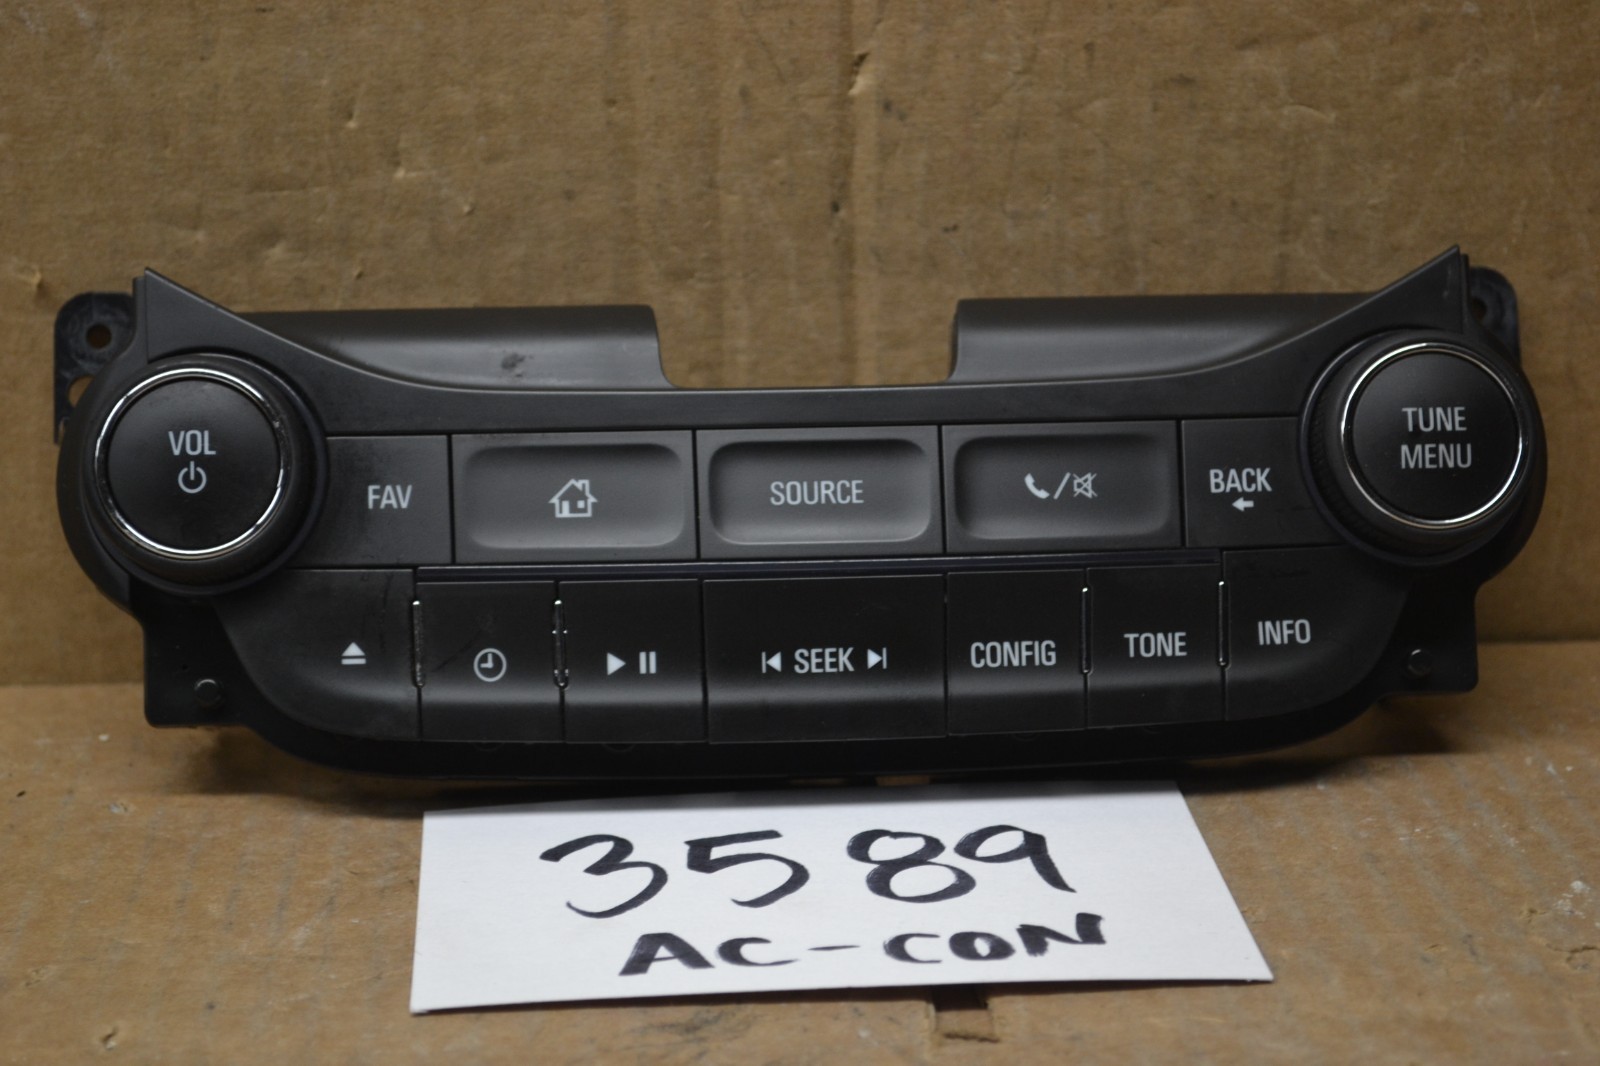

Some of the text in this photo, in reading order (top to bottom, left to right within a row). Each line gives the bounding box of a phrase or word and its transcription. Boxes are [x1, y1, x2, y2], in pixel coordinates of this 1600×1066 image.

[1401, 406, 1468, 432] TUNE
[168, 429, 217, 456] VOL
[1399, 442, 1473, 470] MENU
[769, 478, 865, 506] SOURCE
[1208, 467, 1272, 495] BACK
[366, 484, 413, 510] FAV
[1123, 631, 1187, 658] TONE
[1256, 618, 1312, 646] INFO
[793, 647, 855, 674] SEEK
[969, 639, 1057, 669] CONFIG
[539, 824, 1076, 919] 3589
